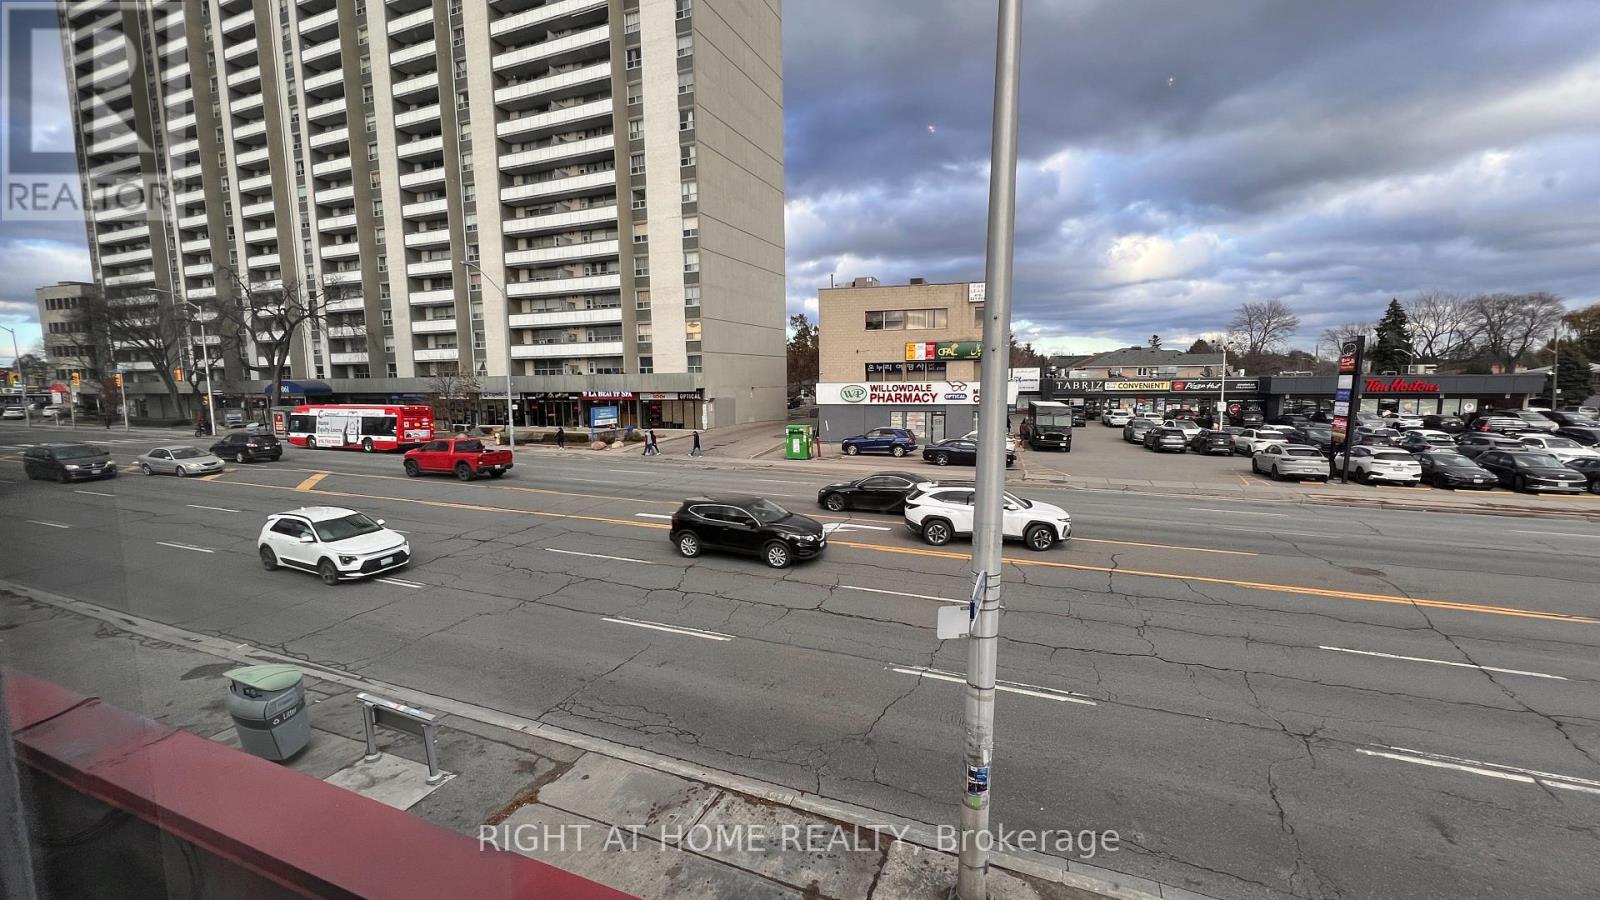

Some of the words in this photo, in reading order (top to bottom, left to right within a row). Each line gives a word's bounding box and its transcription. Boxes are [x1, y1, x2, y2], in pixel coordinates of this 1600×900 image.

[870, 384, 932, 392] WILLOWDALE
[1056, 381, 1104, 390] TABRIZ
[1366, 378, 1390, 392] Tim
[1391, 377, 1440, 392] Hortons
[869, 392, 938, 403] PHARMACY
[282, 706, 297, 720] Litter
